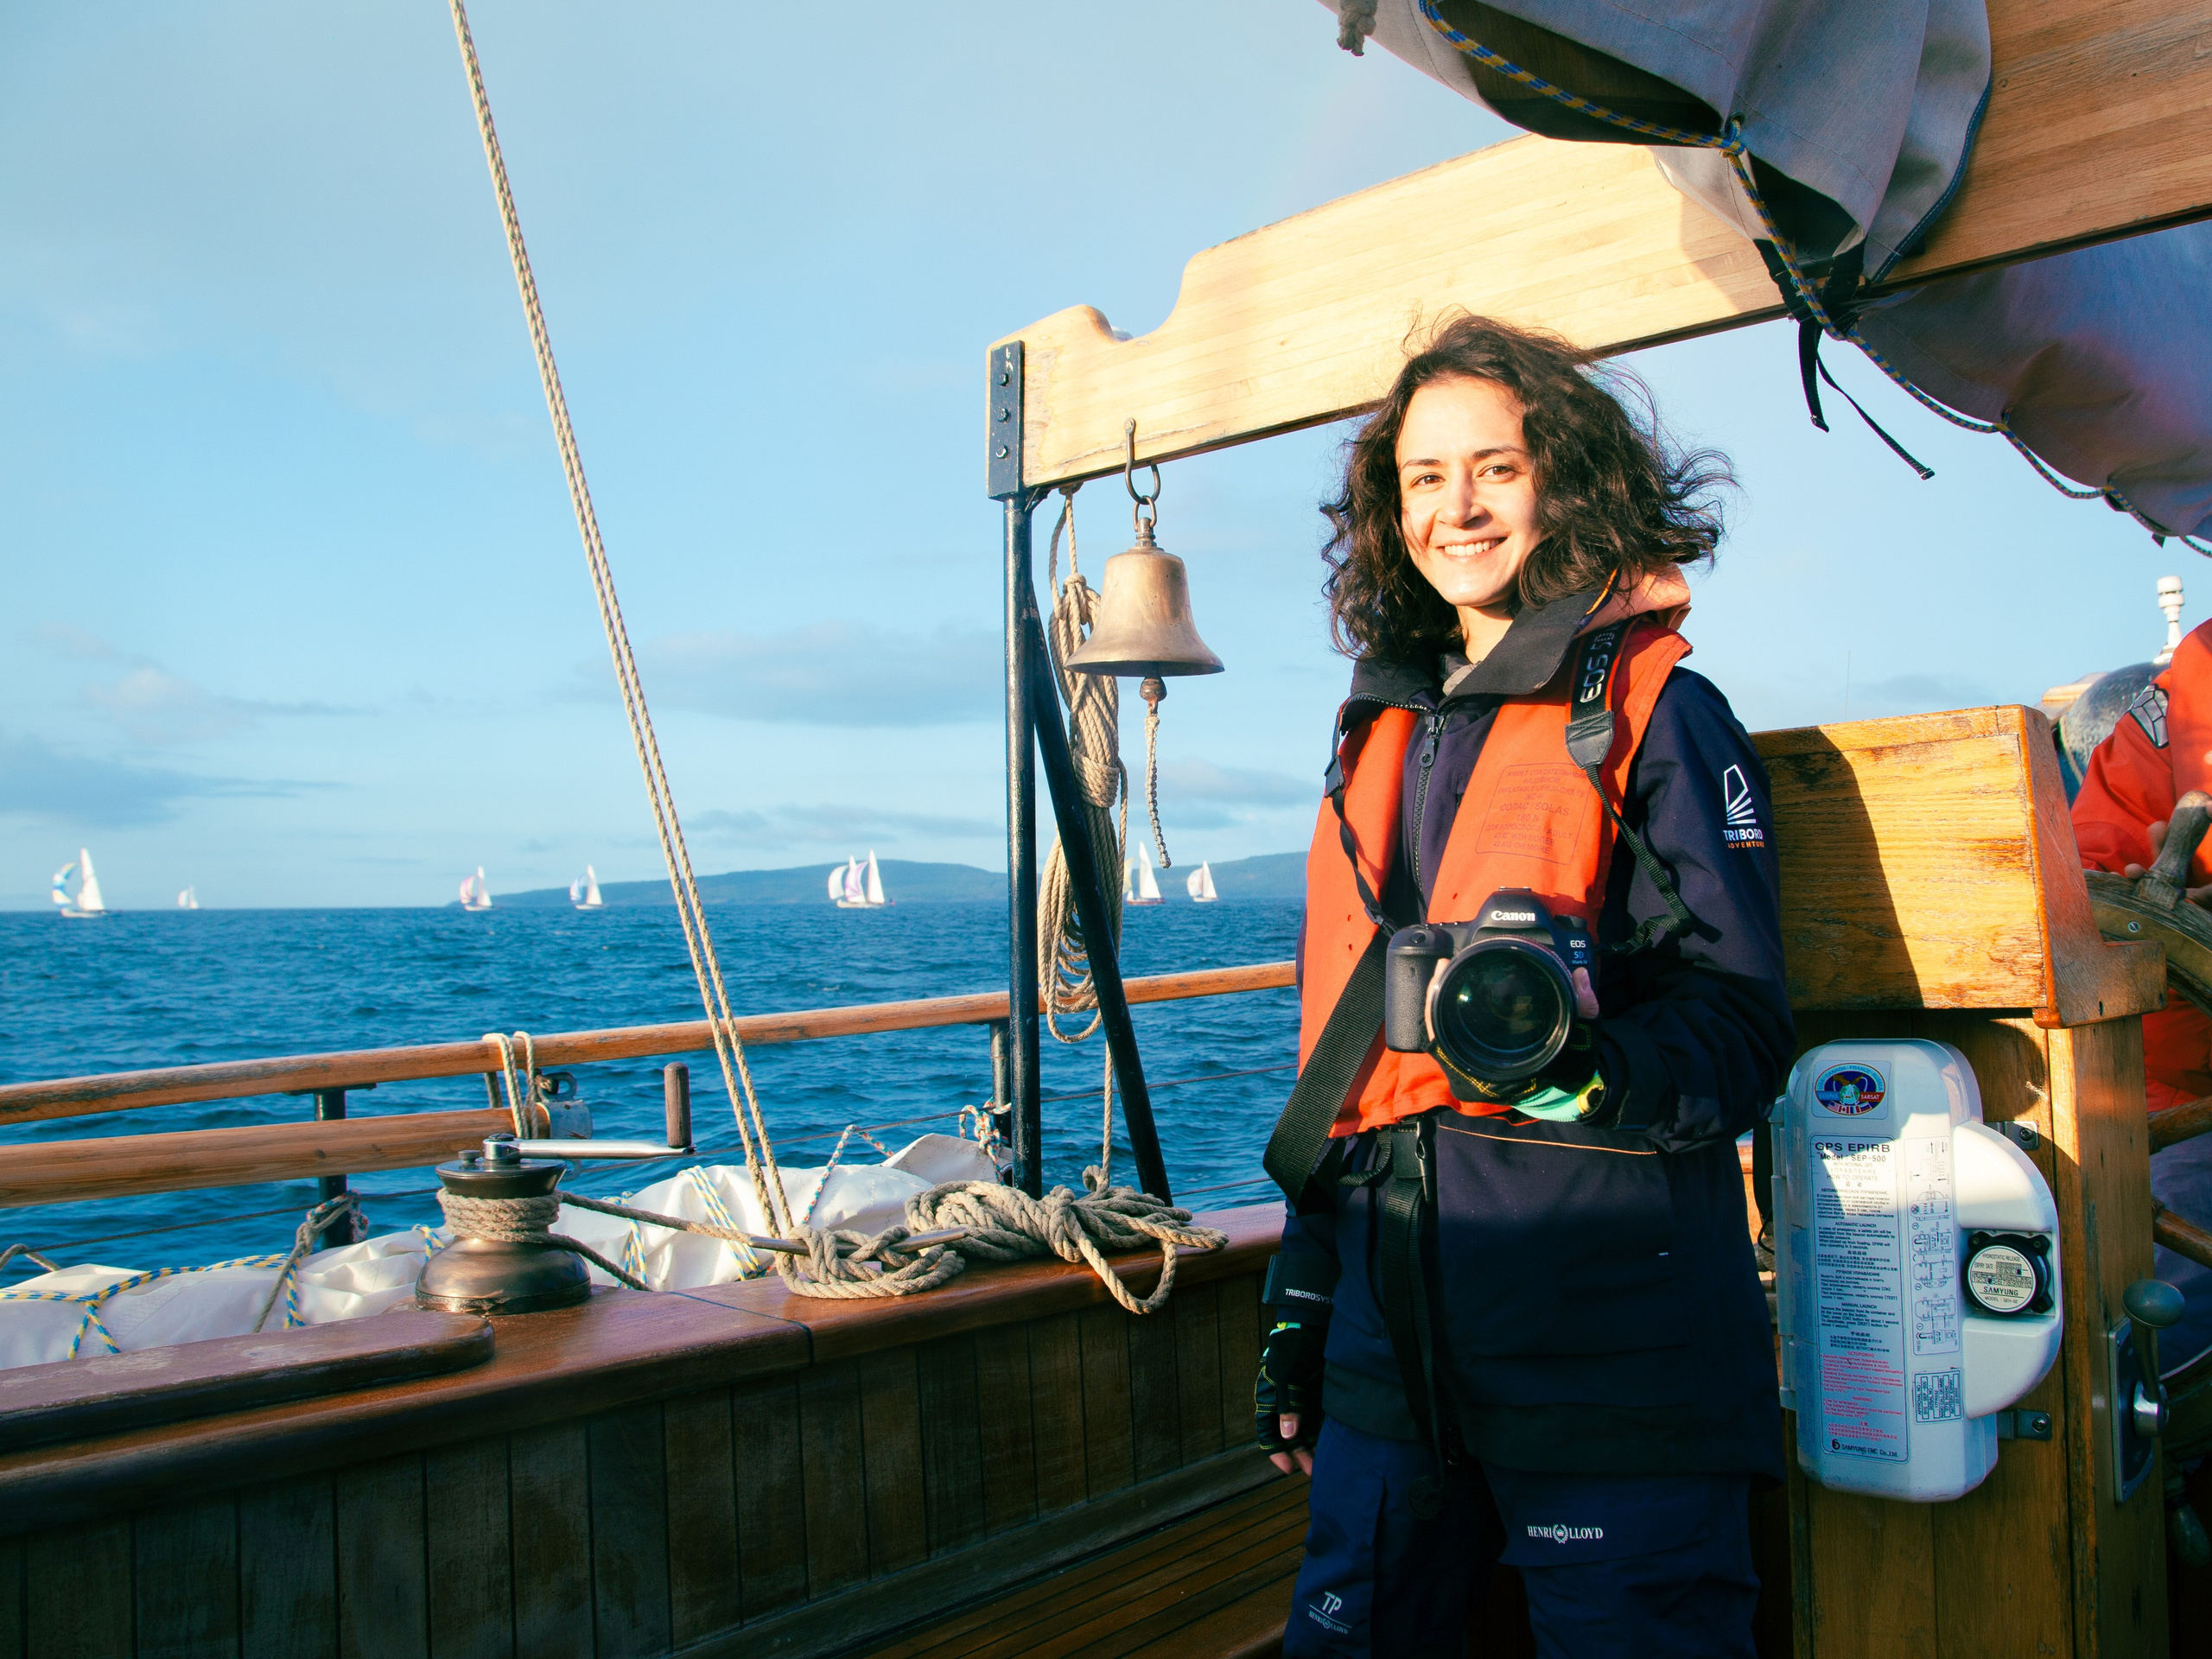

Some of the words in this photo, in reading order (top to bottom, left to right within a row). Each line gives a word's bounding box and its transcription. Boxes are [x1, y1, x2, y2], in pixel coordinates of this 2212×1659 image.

[1580, 654, 1608, 702] EOS
[1498, 785, 1535, 793] INFLATABLE
[1536, 785, 1585, 798] LIFEJACKETS
[1500, 802, 1529, 811] СОЛАС
[1535, 802, 1569, 817] SOLAS
[1548, 829, 1573, 839] ADULT
[1723, 828, 1763, 841] TRIBORD
[1528, 843, 1550, 854] MORE
[1491, 910, 1535, 921] Canon
[1570, 940, 1586, 948] EOS
[1825, 1066, 1847, 1077] CANADA
[1849, 1065, 1870, 1073] FRANCE
[1815, 1142, 1843, 1151] GPS
[1848, 1143, 1890, 1152] EPIRB
[1851, 1154, 1886, 1162] SEP-500
[1983, 1286, 2018, 1296] SAMYUNG
[1841, 1444, 1866, 1452] SAMYUNG
[1527, 1526, 1552, 1538] HENRI
[1569, 1527, 1603, 1539] LLOYD
[1322, 1591, 1342, 1615] TP
[1309, 1611, 1322, 1624] HENRI
[1331, 1623, 1348, 1634] LLOYD
